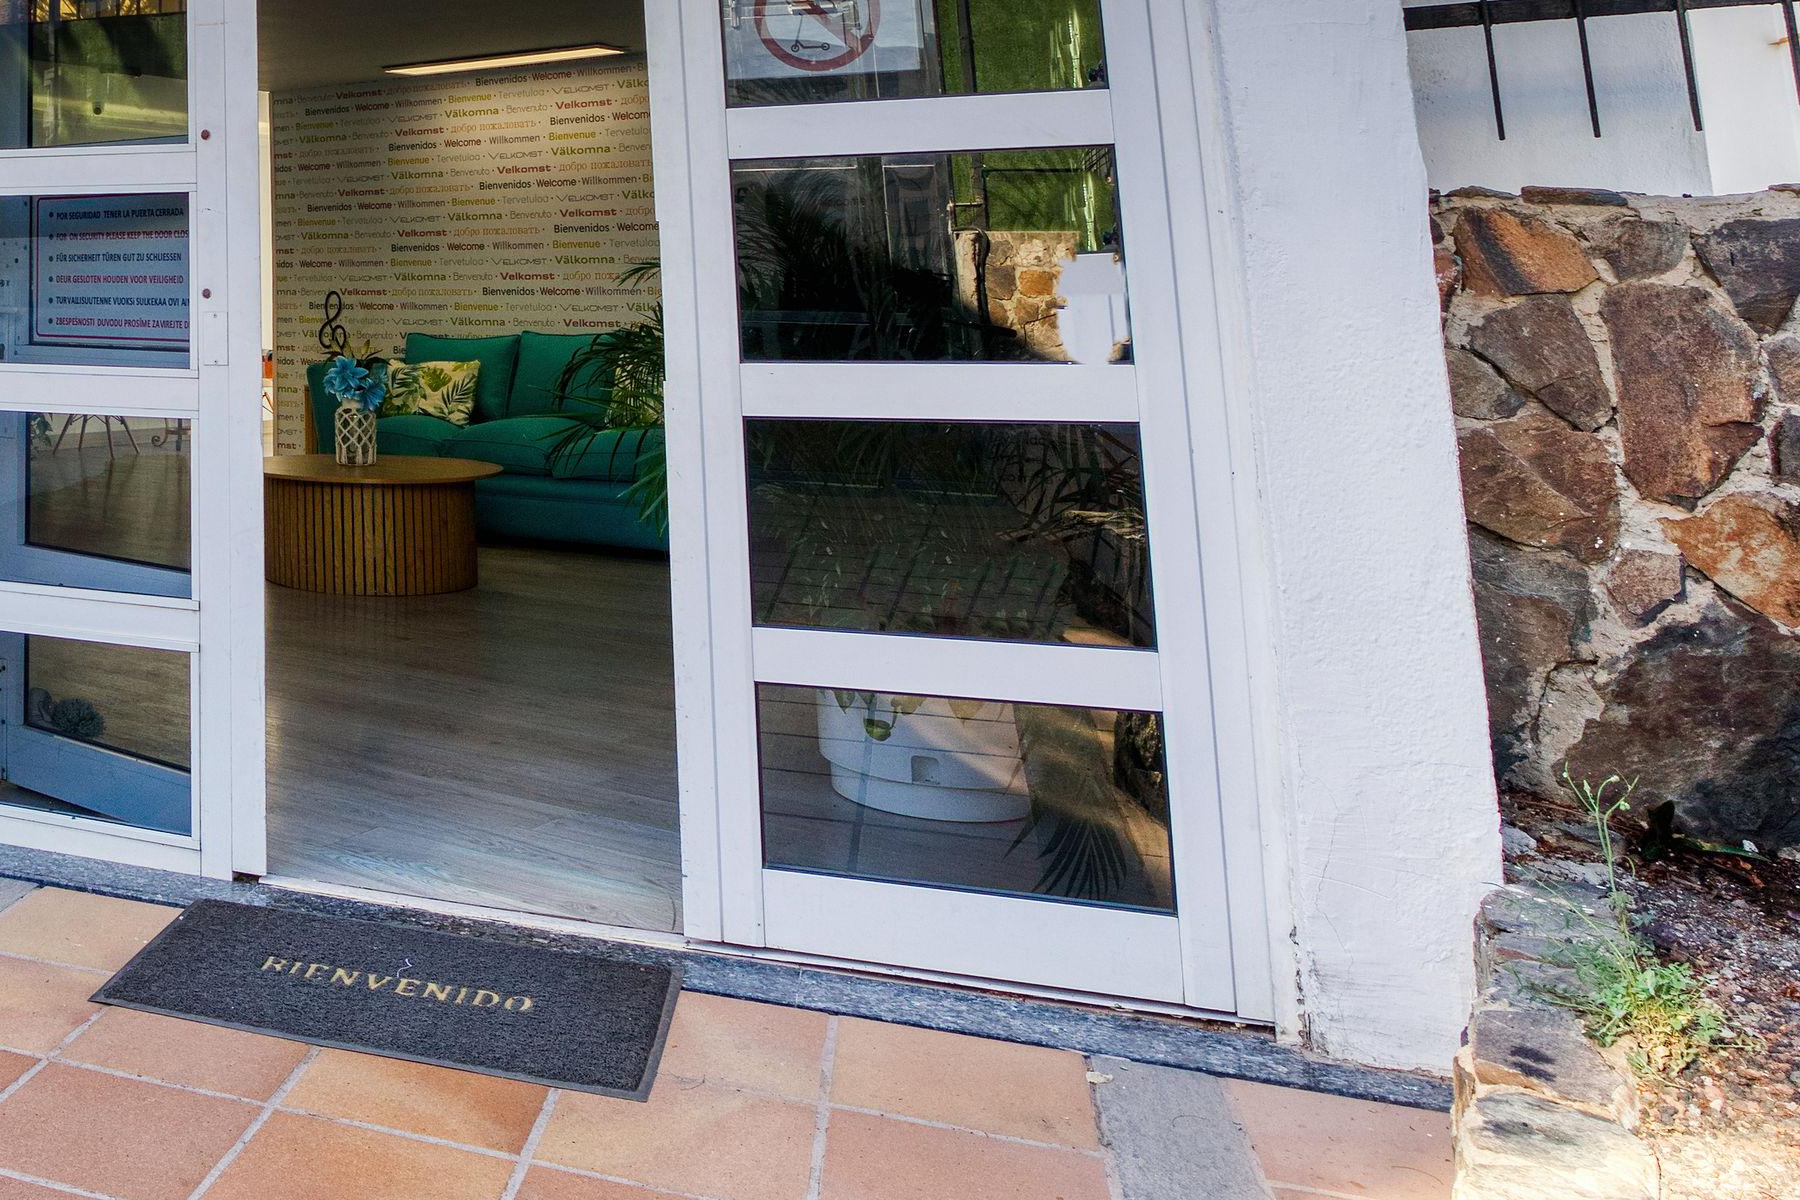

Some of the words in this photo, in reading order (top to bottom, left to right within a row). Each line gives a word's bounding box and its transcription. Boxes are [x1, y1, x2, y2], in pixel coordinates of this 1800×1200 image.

[475, 73, 527, 87] Bienvenidos
[532, 70, 572, 81] Welcome
[577, 64, 631, 77] Willkommen
[336, 89, 382, 100] Velkomst
[305, 105, 349, 116] Bienvenidos
[355, 101, 389, 112] Welcome
[394, 96, 442, 108] Willkommen
[448, 92, 492, 104] Bienvenue
[295, 120, 334, 131] Bienvenue
[445, 107, 499, 119] Välkomna
[556, 99, 612, 110] Velkomst
[550, 113, 605, 126] Bienvenidos
[612, 110, 650, 121] Welcom
[299, 133, 346, 145] Välkomna
[395, 126, 444, 137] Velkomst
[389, 141, 436, 152] Bienvenidos
[444, 138, 481, 148] Welcome
[489, 133, 540, 145] Willkommen
[549, 130, 596, 141] Bienvenue
[298, 161, 330, 171] Welcome
[336, 159, 381, 169] Willkommen
[388, 156, 429, 166] Bienvenue
[551, 145, 611, 156] Välkomna
[391, 170, 443, 181] Välkomna
[497, 164, 551, 175] Velkomst
[480, 178, 531, 190] Bienvenidos
[536, 175, 576, 187] Welcome
[582, 173, 637, 185] Willkommen
[338, 186, 385, 196] Velkomst
[307, 202, 351, 212] Bienvenidos
[357, 200, 392, 210] Welcome
[398, 198, 445, 208] Willkommen
[452, 197, 495, 207] Bienvenue
[123, 210, 130, 218] LA
[132, 209, 154, 218] PUERTA
[155, 208, 184, 217] CERRADA
[297, 216, 336, 226] Bienvenue
[448, 212, 502, 221] Välkomna
[560, 208, 616, 219] Velkomst
[554, 223, 609, 234] Bienvenidos
[616, 222, 659, 232] Welcome
[79, 232, 105, 240] SECURITY
[127, 231, 141, 239] KEEP
[142, 231, 154, 239] THE
[155, 230, 172, 238] DOOR
[301, 231, 348, 241] Välkomna
[398, 229, 447, 238] Velkomst
[391, 242, 439, 253] Bienvenidos
[447, 242, 485, 251] Welcome
[492, 241, 543, 250] Willkommen
[552, 240, 600, 249] Bienvenue
[56, 253, 67, 262] FÜR
[68, 254, 100, 262] SICHERHEIT
[102, 252, 121, 261] TÜREN
[137, 253, 144, 261] ZU
[299, 259, 332, 268] Welcome
[339, 258, 383, 267] Willkommen
[391, 258, 431, 267] Bienvenue
[555, 255, 614, 265] Välkomna
[56, 275, 71, 283] DEUR
[73, 275, 101, 283] GESLOTEN
[149, 276, 183, 284] VEILIGHEID
[394, 272, 446, 281] Välkomna
[500, 272, 555, 281] Velkomst
[340, 288, 387, 296] Velkomst
[482, 286, 535, 296] Bienvenidos
[540, 286, 580, 296] Welcome
[586, 286, 641, 296] Willkommen
[113, 297, 135, 305] VUOKSI
[136, 297, 166, 306] SULKEKAA
[168, 298, 179, 306] OVI
[359, 301, 394, 310] Welcome
[400, 301, 448, 310] Willkommen
[455, 302, 498, 311] Bienvenue
[450, 316, 505, 326] Välkomna
[563, 318, 620, 328] Velkomst
